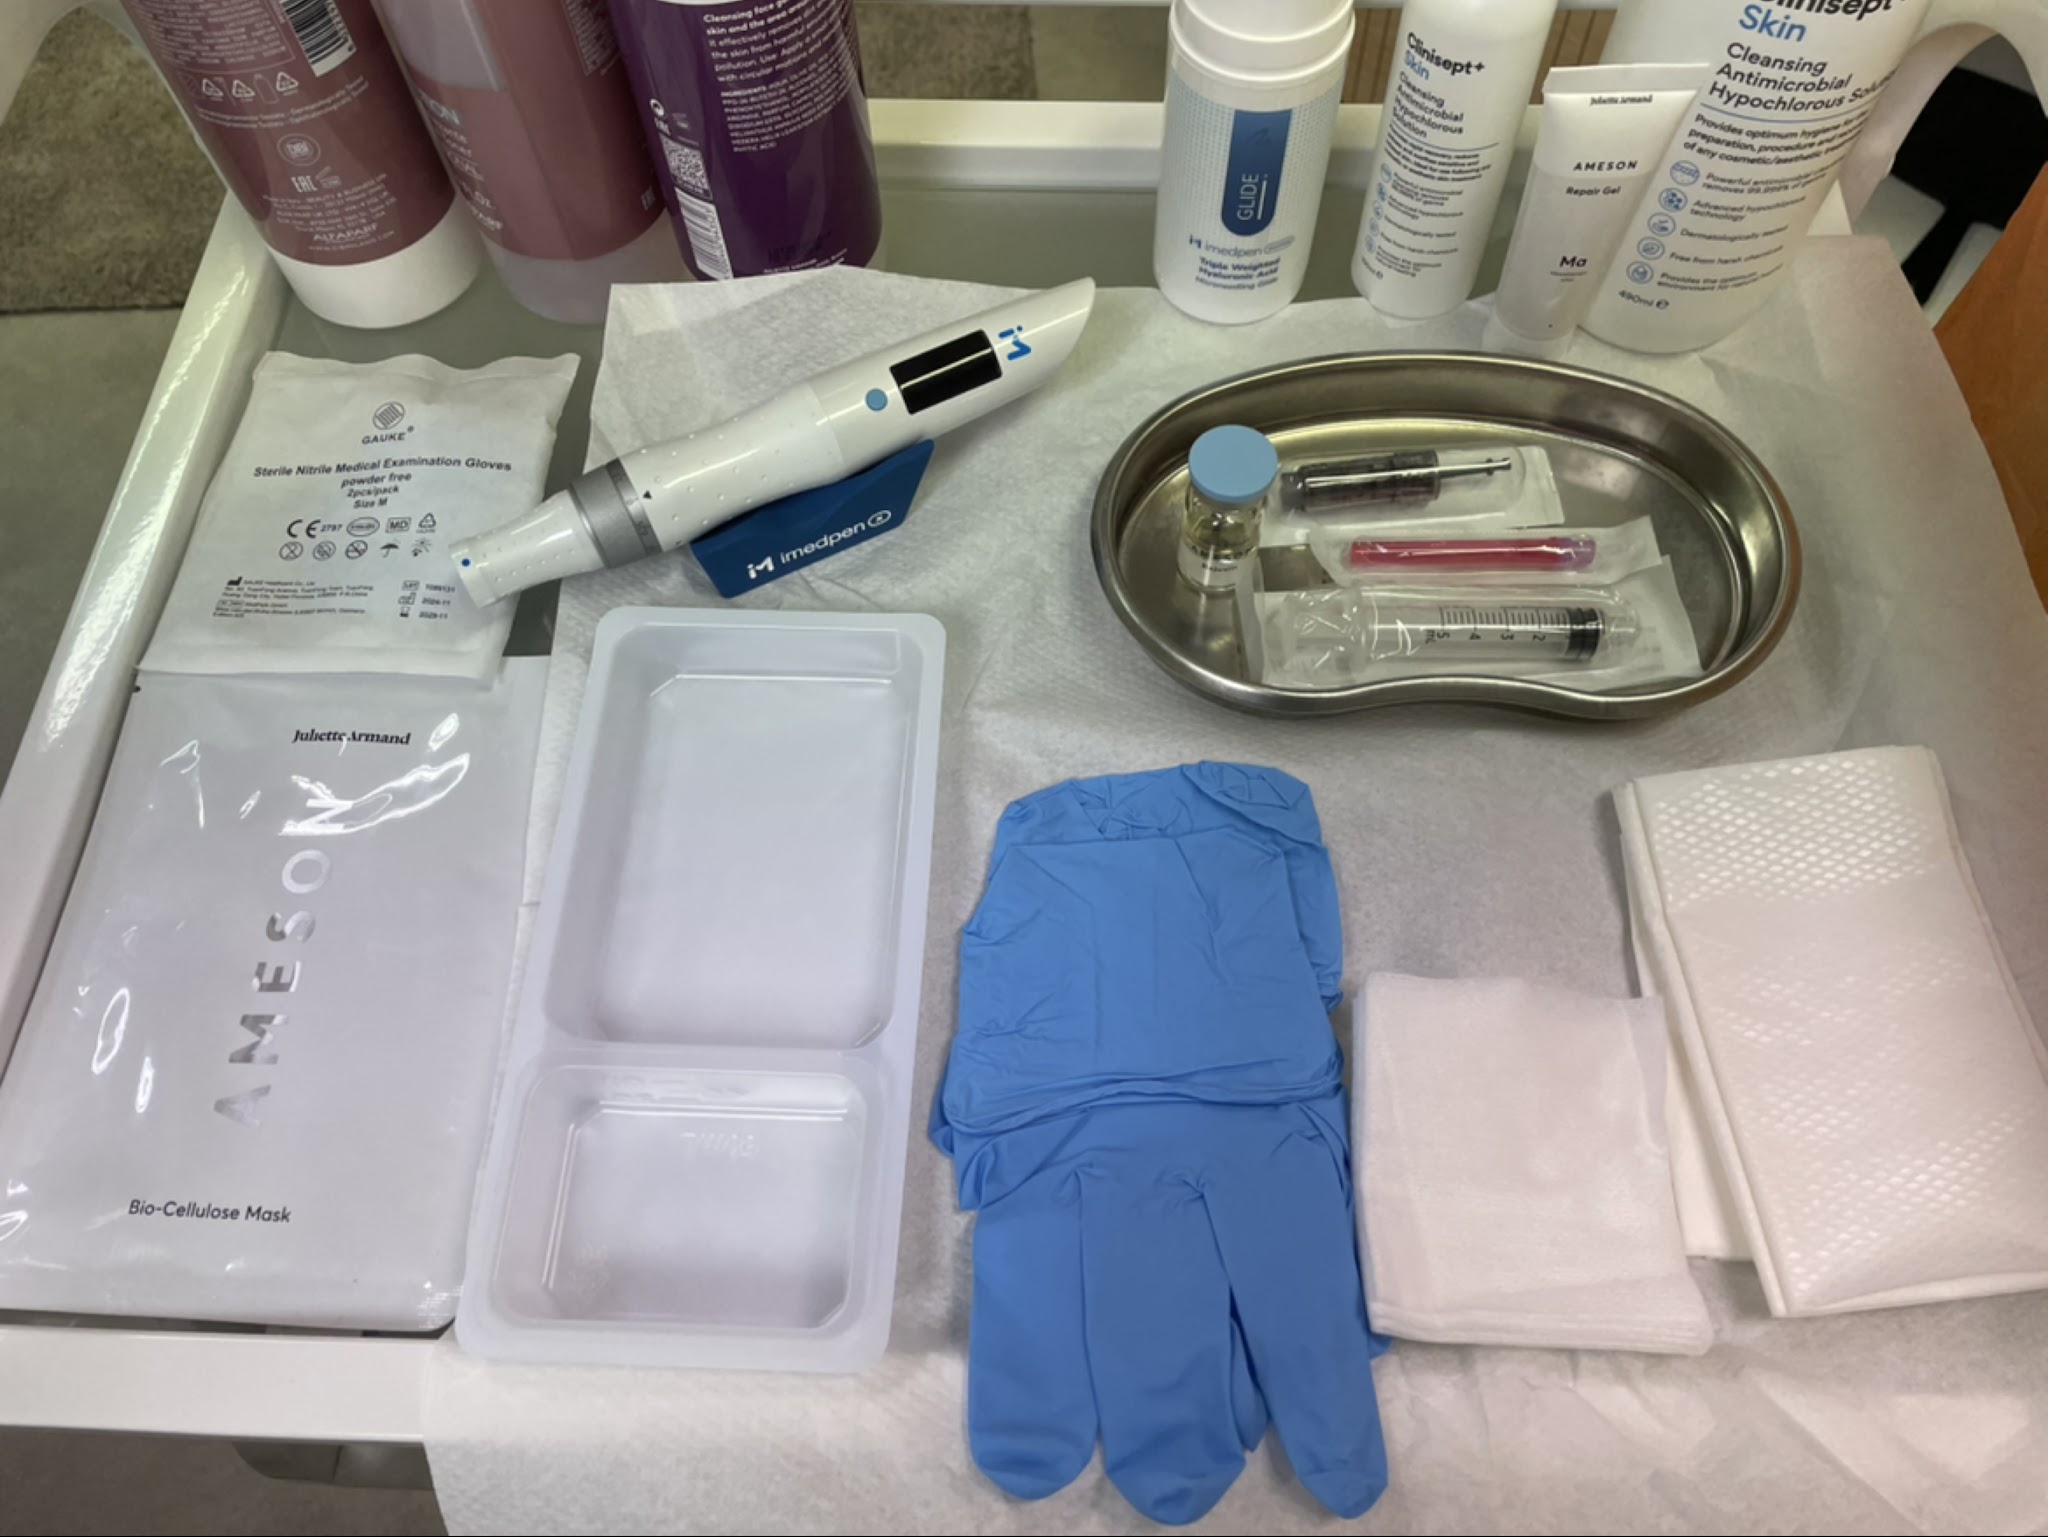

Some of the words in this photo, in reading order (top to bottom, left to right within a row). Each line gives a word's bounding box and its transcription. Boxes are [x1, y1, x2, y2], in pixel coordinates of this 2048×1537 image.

[703, 9, 754, 23] Cleansing
[754, 3, 775, 16] face
[706, 26, 728, 36] skin
[729, 22, 749, 33] and
[749, 18, 766, 29] the
[1739, 4, 1807, 43] Skin
[718, 31, 767, 47] effectively
[711, 50, 729, 60] the
[730, 47, 751, 58] skin
[751, 41, 774, 54] from
[1407, 32, 1485, 76] Clinisept+
[1405, 50, 1430, 80] Skin
[1727, 42, 1828, 77] Cleansing
[717, 73, 738, 83] with
[739, 66, 774, 81] circular
[1716, 63, 1853, 93] Antimicrobial
[1399, 71, 1446, 108] Cleansing
[1709, 81, 1845, 111] Hypochlorous
[1397, 85, 1465, 122] Antimicrobial
[1393, 106, 1428, 138] Solution
[1395, 95, 1464, 134] Hypochlorous
[1694, 113, 1743, 138] Provides
[1745, 128, 1799, 141] optimum
[1687, 129, 1756, 153] preparation,
[1756, 139, 1817, 154] procedure
[1682, 141, 1698, 152] of
[1696, 146, 1717, 163] any
[1573, 160, 1638, 171] AMESON
[1706, 172, 1752, 186] Powerful
[1237, 173, 1259, 220] GLIDE
[1566, 185, 1600, 197] Repair
[1602, 185, 1621, 196] Gel
[1702, 182, 1746, 194] removes
[1690, 208, 1747, 222] technology
[1693, 200, 1746, 213] Advanced
[1680, 228, 1760, 243] Dermatologically
[1205, 241, 1263, 258] imedpen
[1200, 257, 1228, 271] Triple
[1232, 257, 1280, 272] Weighted
[1559, 255, 1588, 268] Ma
[1669, 252, 1692, 264] Free
[1693, 256, 1716, 265] from
[1717, 256, 1743, 265] harsh
[1198, 267, 1253, 280] Hyaluronic
[1256, 266, 1279, 278] Acid
[1660, 272, 1701, 286] Provides
[254, 465, 292, 478] Sterile
[295, 462, 332, 476] Nitrile
[335, 458, 381, 474] Medical
[383, 456, 461, 470] Examination
[465, 457, 512, 472] Gloves
[341, 476, 386, 489] powder
[388, 472, 412, 484] free
[347, 484, 400, 498] 2pcs/pack
[353, 498, 377, 509] Size
[378, 497, 388, 507] M
[390, 520, 409, 530] MD
[780, 521, 866, 564] imedpen
[1500, 631, 1515, 641] 3
[1533, 631, 1547, 642] 2
[292, 728, 347, 744] Juliette
[214, 798, 353, 1129] AMESON
[128, 1198, 240, 1220] Bio-Cellulose
[245, 1205, 292, 1223] Mask
